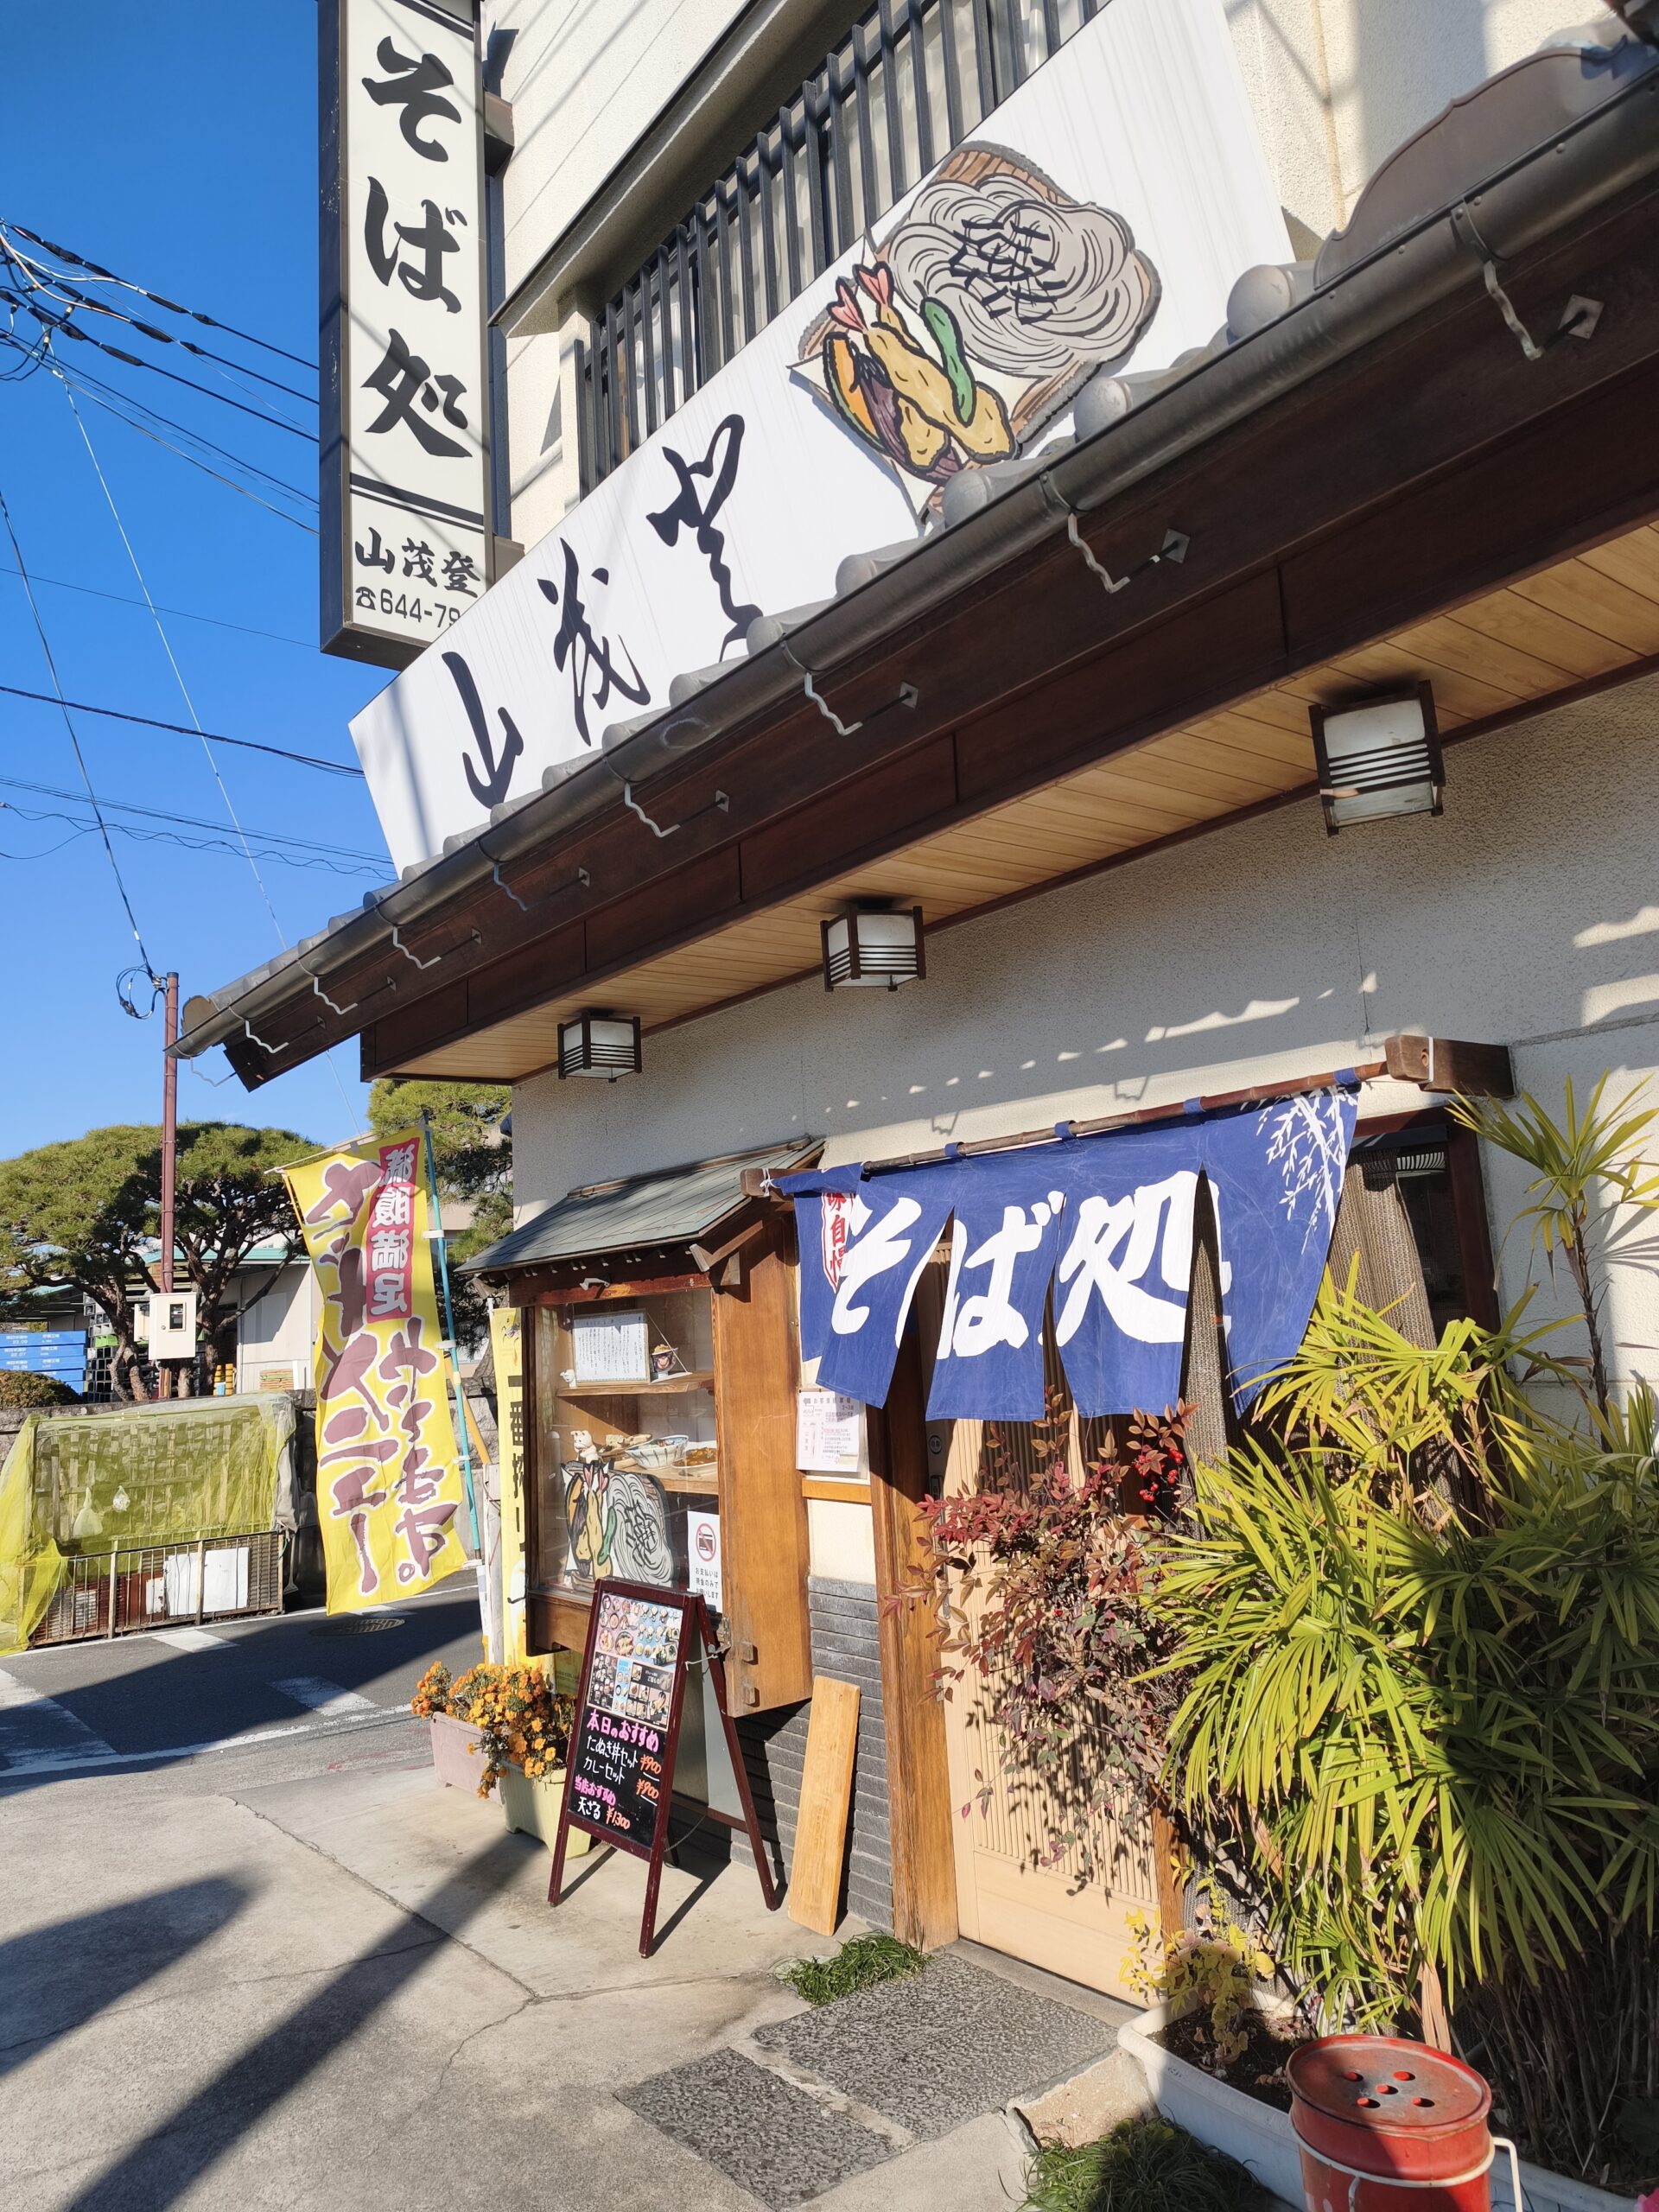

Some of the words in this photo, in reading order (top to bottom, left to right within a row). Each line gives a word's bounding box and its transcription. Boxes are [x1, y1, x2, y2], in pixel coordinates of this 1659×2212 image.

[361, 35, 473, 458] そば処
[354, 526, 480, 599] 山茂登
[831, 1170, 1232, 1359] そば処
[586, 1707, 659, 1753] 本日のおすすめ
[574, 1774, 617, 1807] 当店おすすめ
[582, 1756, 626, 1786] カレーセット
[577, 1796, 601, 1821] 天ざる
